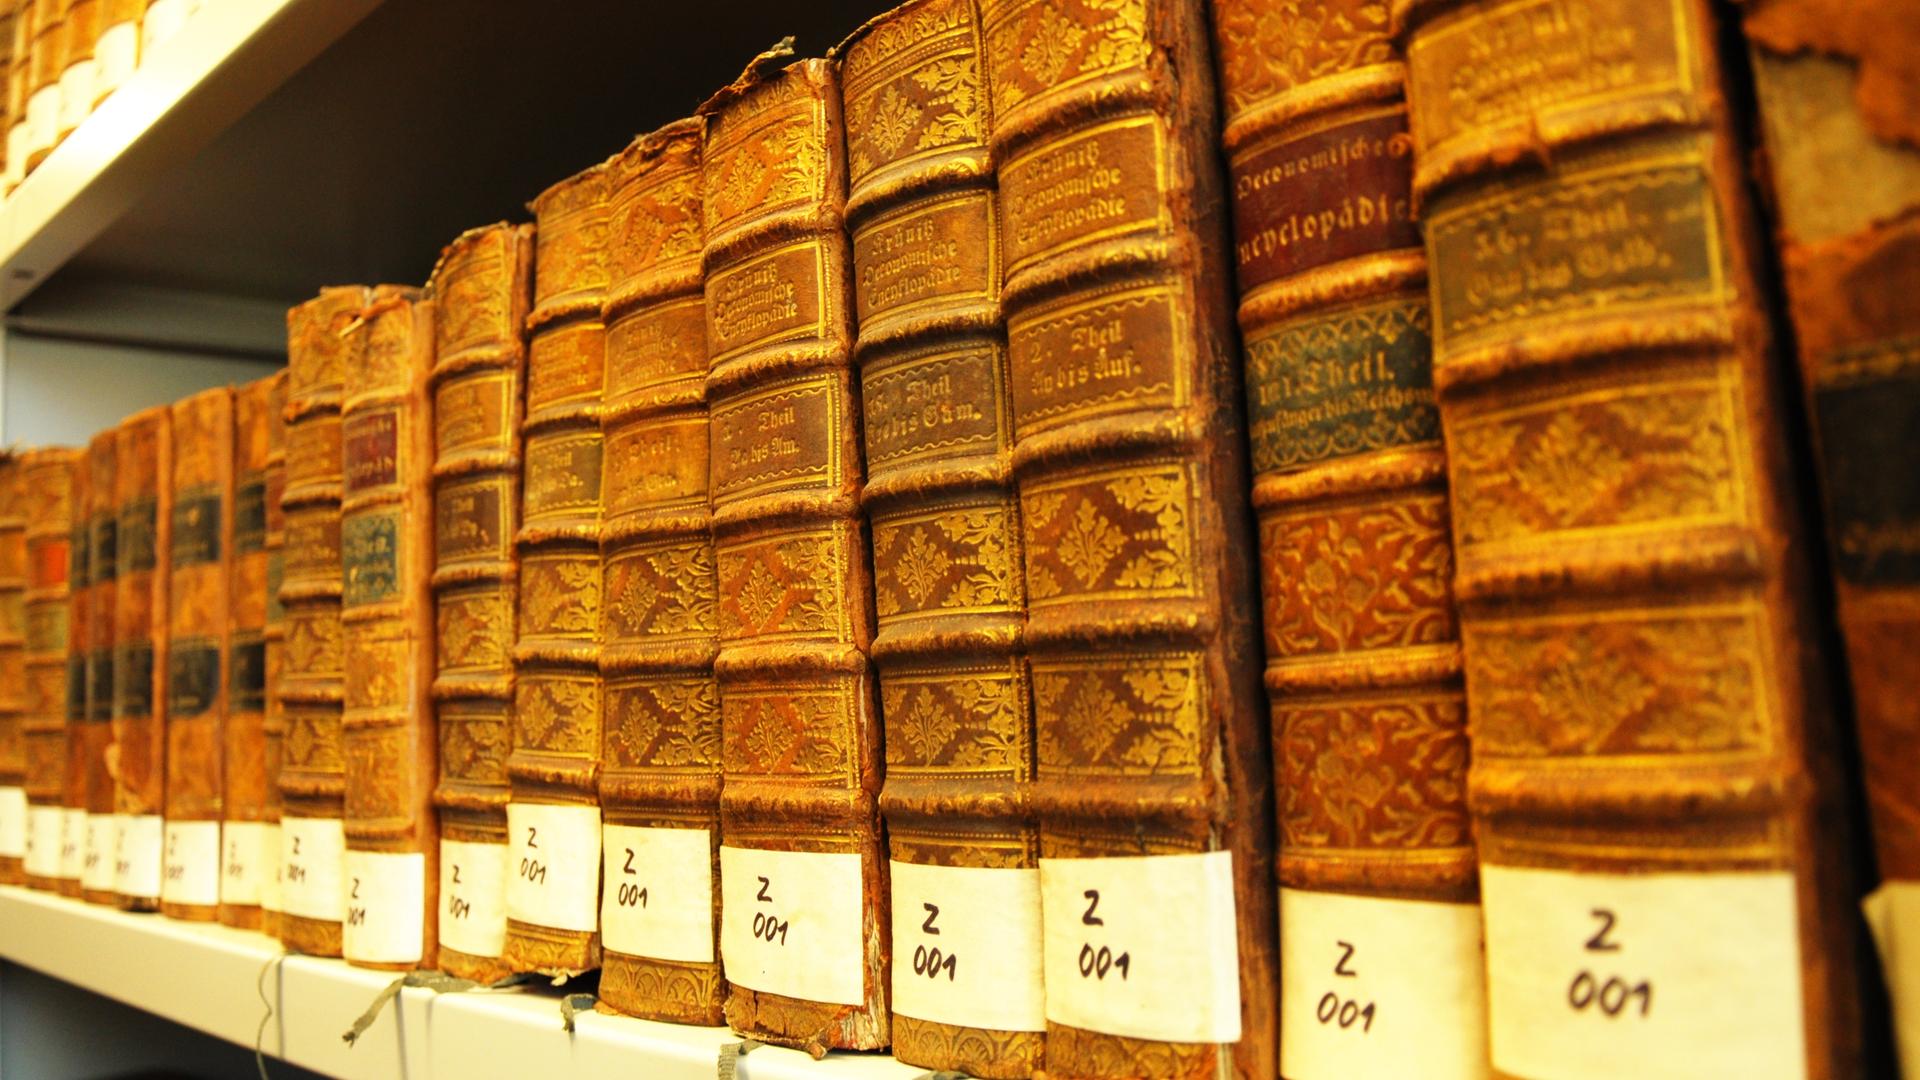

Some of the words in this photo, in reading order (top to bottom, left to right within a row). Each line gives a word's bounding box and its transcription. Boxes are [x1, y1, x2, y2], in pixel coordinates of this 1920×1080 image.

[521, 857, 547, 885] 001
[618, 882, 648, 909] 001
[753, 912, 789, 946] 001
[913, 944, 957, 982] 001
[1079, 943, 1130, 981] 001
[1316, 990, 1376, 1034] 001
[1568, 970, 1653, 1019] 001
